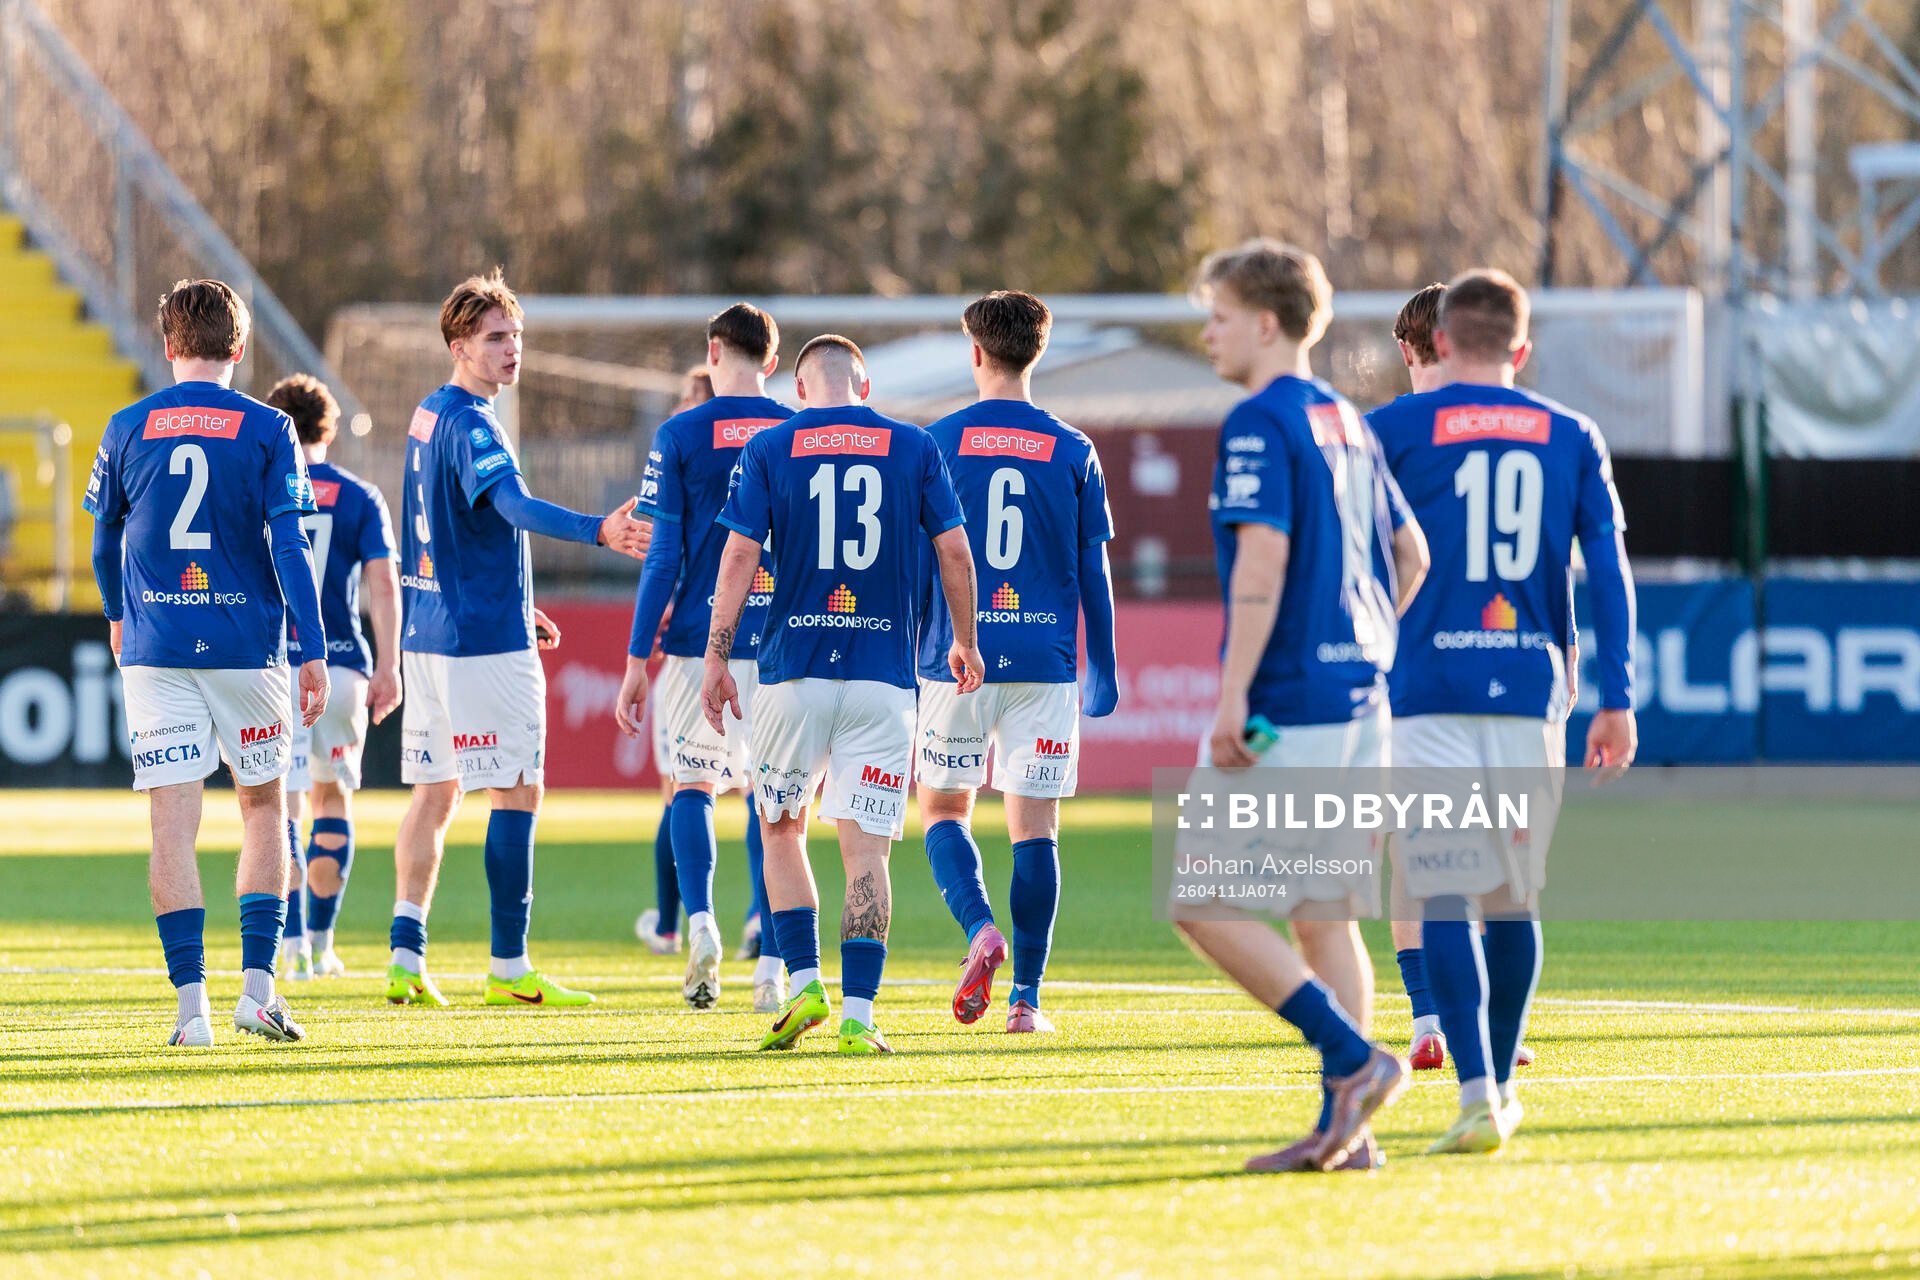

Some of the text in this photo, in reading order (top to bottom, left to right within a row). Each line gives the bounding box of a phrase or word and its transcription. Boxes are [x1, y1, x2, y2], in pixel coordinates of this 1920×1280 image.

[155, 414, 231, 431] elcenter
[723, 424, 770, 440] elce
[1446, 411, 1539, 435] elcenter
[803, 433, 880, 449] elcenter
[971, 432, 1045, 453] elcenter
[169, 443, 211, 550] 2
[809, 463, 882, 571] 13
[985, 467, 1026, 570] 6
[1455, 449, 1544, 582] 19
[142, 590, 247, 605] OLOFSSON BYGG
[788, 614, 892, 631] OLOFSSON BYGG
[1023, 612, 1057, 624] BYGG
[140, 724, 197, 740] SCANDICORE
[240, 722, 282, 745] MAXI
[453, 733, 497, 750] MAXI
[134, 744, 201, 770] INSECTA
[240, 745, 280, 770] ERLA
[862, 764, 904, 790] MAXI
[1024, 764, 1066, 781] ERL
[851, 793, 897, 817] ERLA
